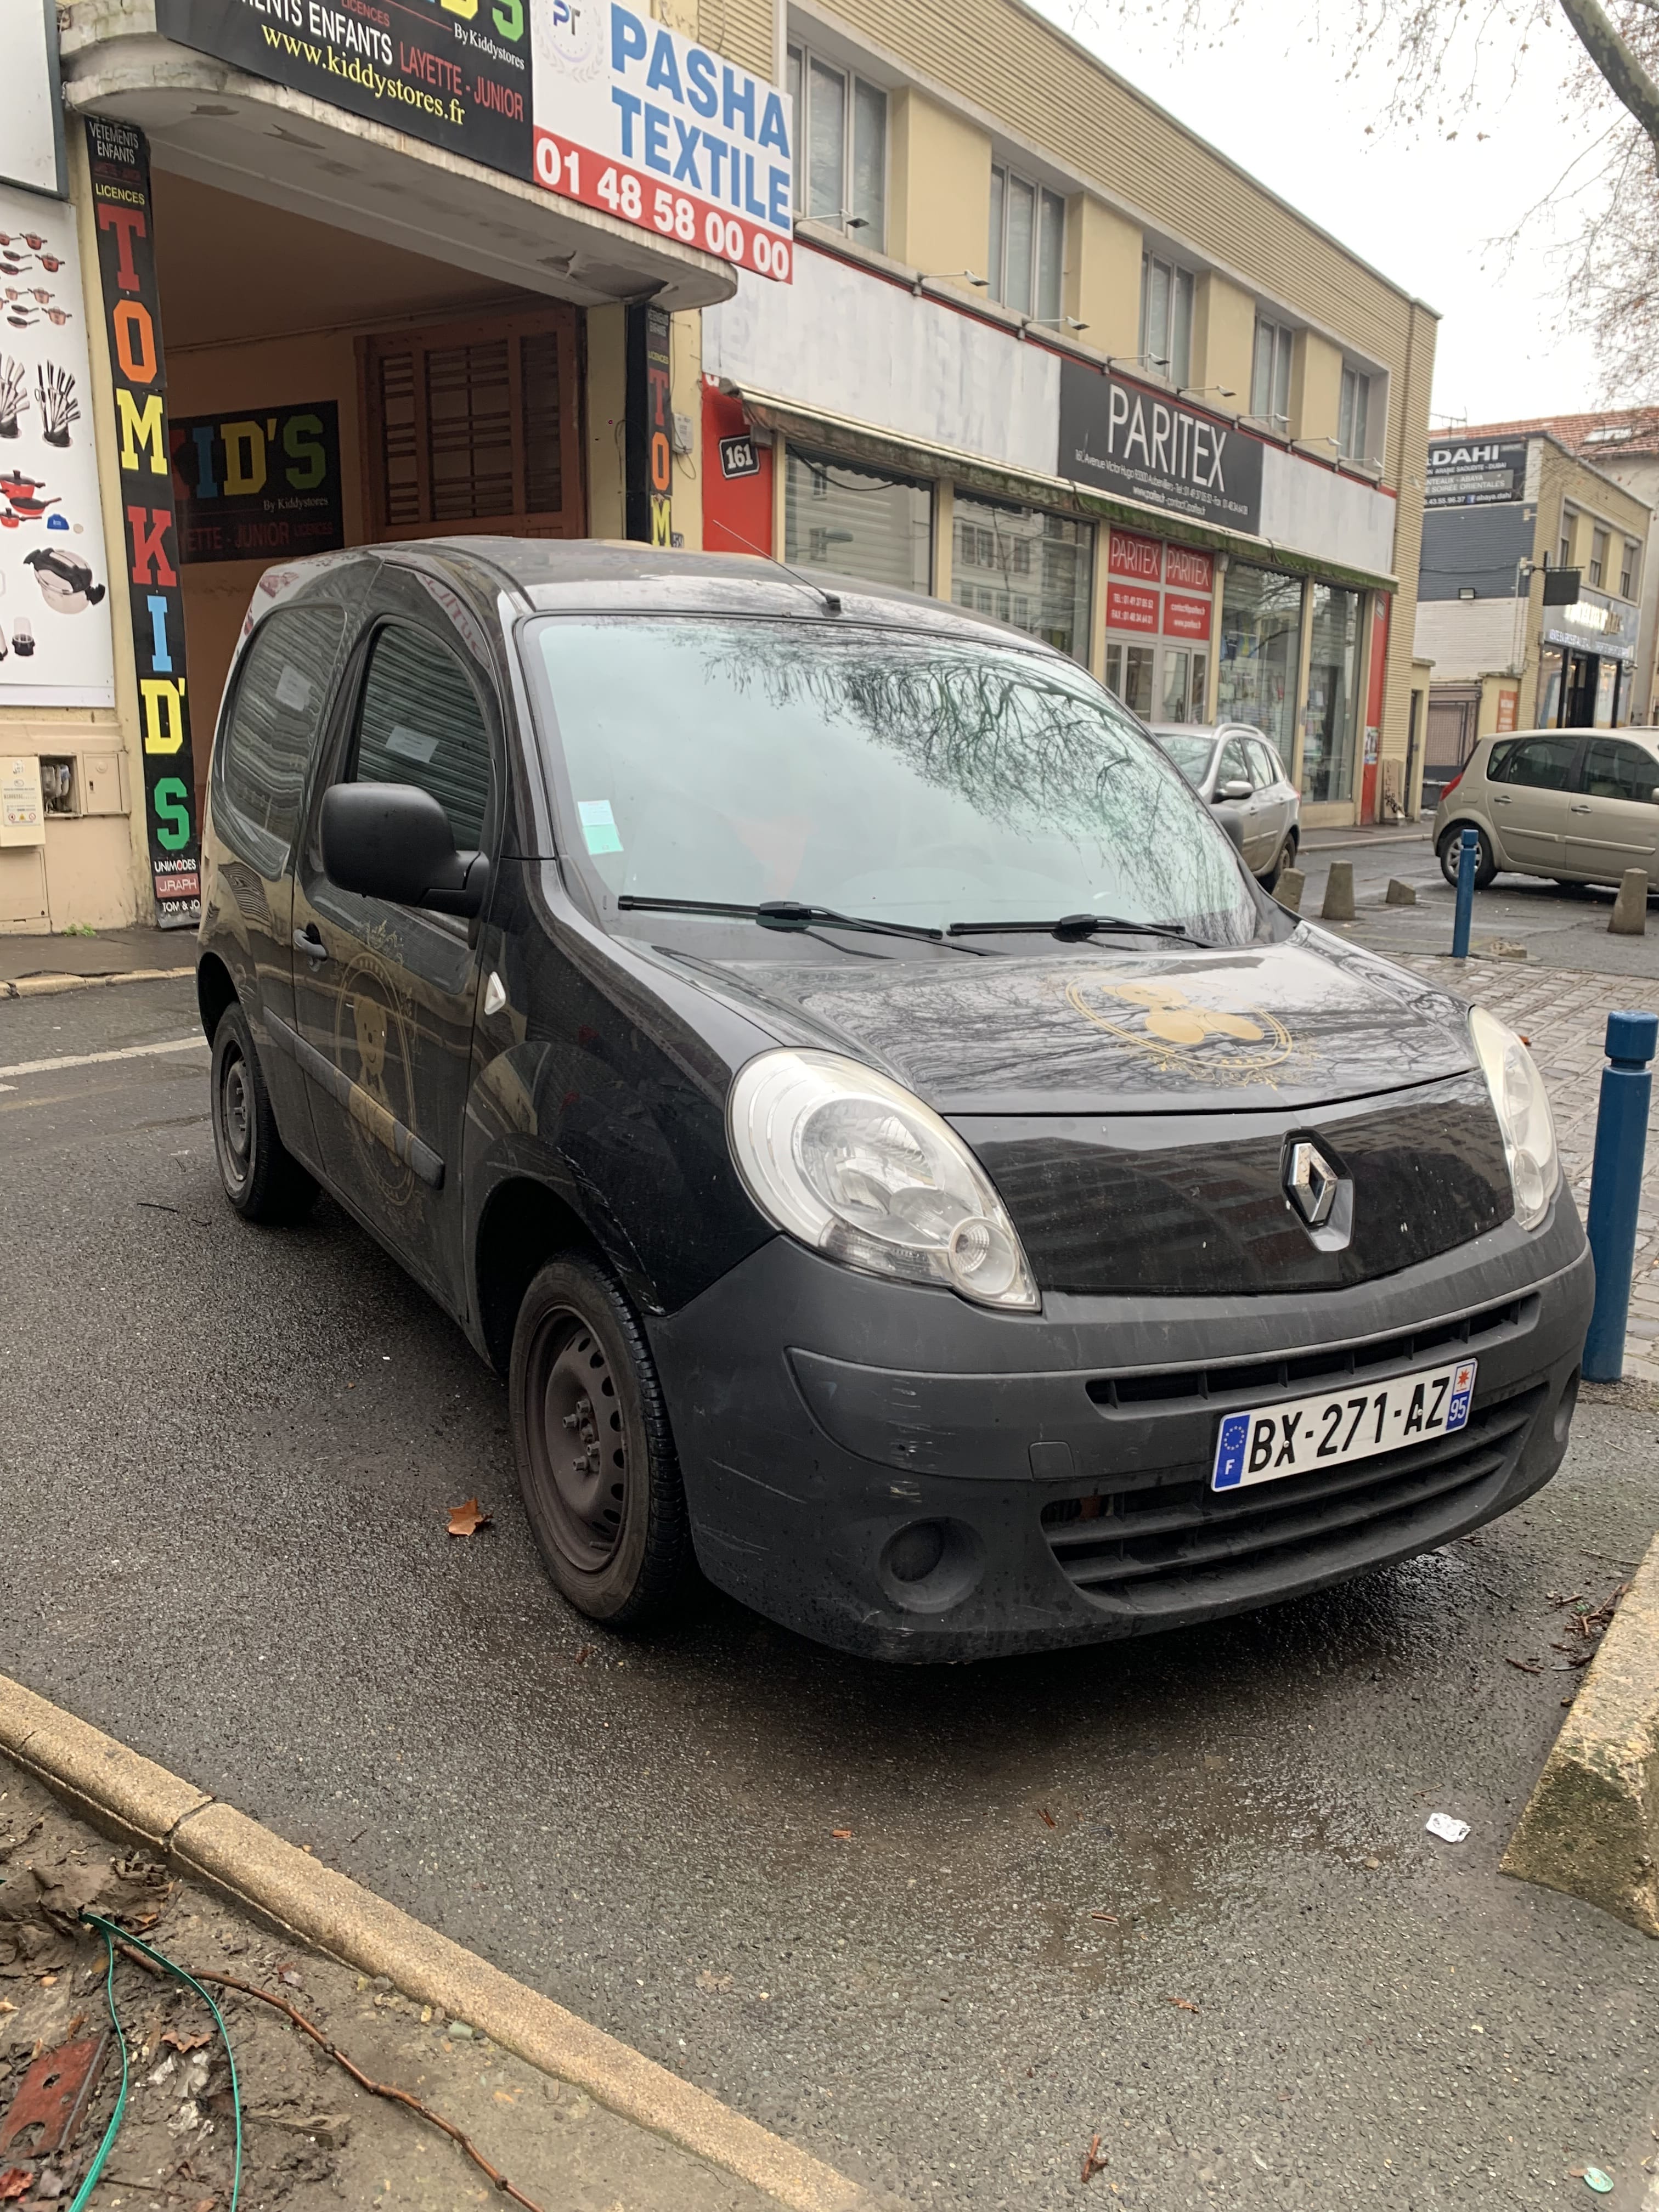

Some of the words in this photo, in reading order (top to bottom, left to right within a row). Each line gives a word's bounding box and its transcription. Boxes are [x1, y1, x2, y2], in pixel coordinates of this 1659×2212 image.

[309, 1, 393, 65] ENFANTS
[399, 41, 462, 95] LAYETTE
[474, 76, 524, 122] JUNIOR
[454, 22, 469, 45] By
[470, 29, 525, 70] Kiddystores
[262, 24, 465, 125] www.kiddystores.fr
[611, 2, 791, 159] PASHA
[97, 140, 135, 164] ENFANTS
[611, 84, 791, 230] TEXTILE
[95, 183, 145, 205] LICENCES
[537, 137, 579, 195] 01
[597, 167, 642, 219] 48
[653, 189, 695, 241] 58
[706, 212, 744, 261] 00
[753, 233, 789, 279] 00
[1108, 384, 1227, 492] PARITEX
[726, 443, 754, 470] 161
[1085, 453, 1106, 469] Avenue
[1106, 460, 1121, 473] Victor
[1121, 465, 1135, 479] Hugo
[1460, 479, 1505, 490] ORIENTALES
[1461, 474, 1483, 482] ABAYA
[263, 500, 276, 513] By
[236, 522, 290, 548] JUNIOR
[1111, 537, 1159, 575] PARITEX
[1167, 550, 1209, 586] PARITEX
[154, 859, 196, 872] UNIMODES
[162, 901, 180, 912] TOM
[182, 900, 188, 911] &
[190, 899, 200, 910] JO
[1225, 1458, 1235, 1475] F
[1248, 1376, 1451, 1474] BX-271-AZ
[1449, 1396, 1468, 1421] 95
